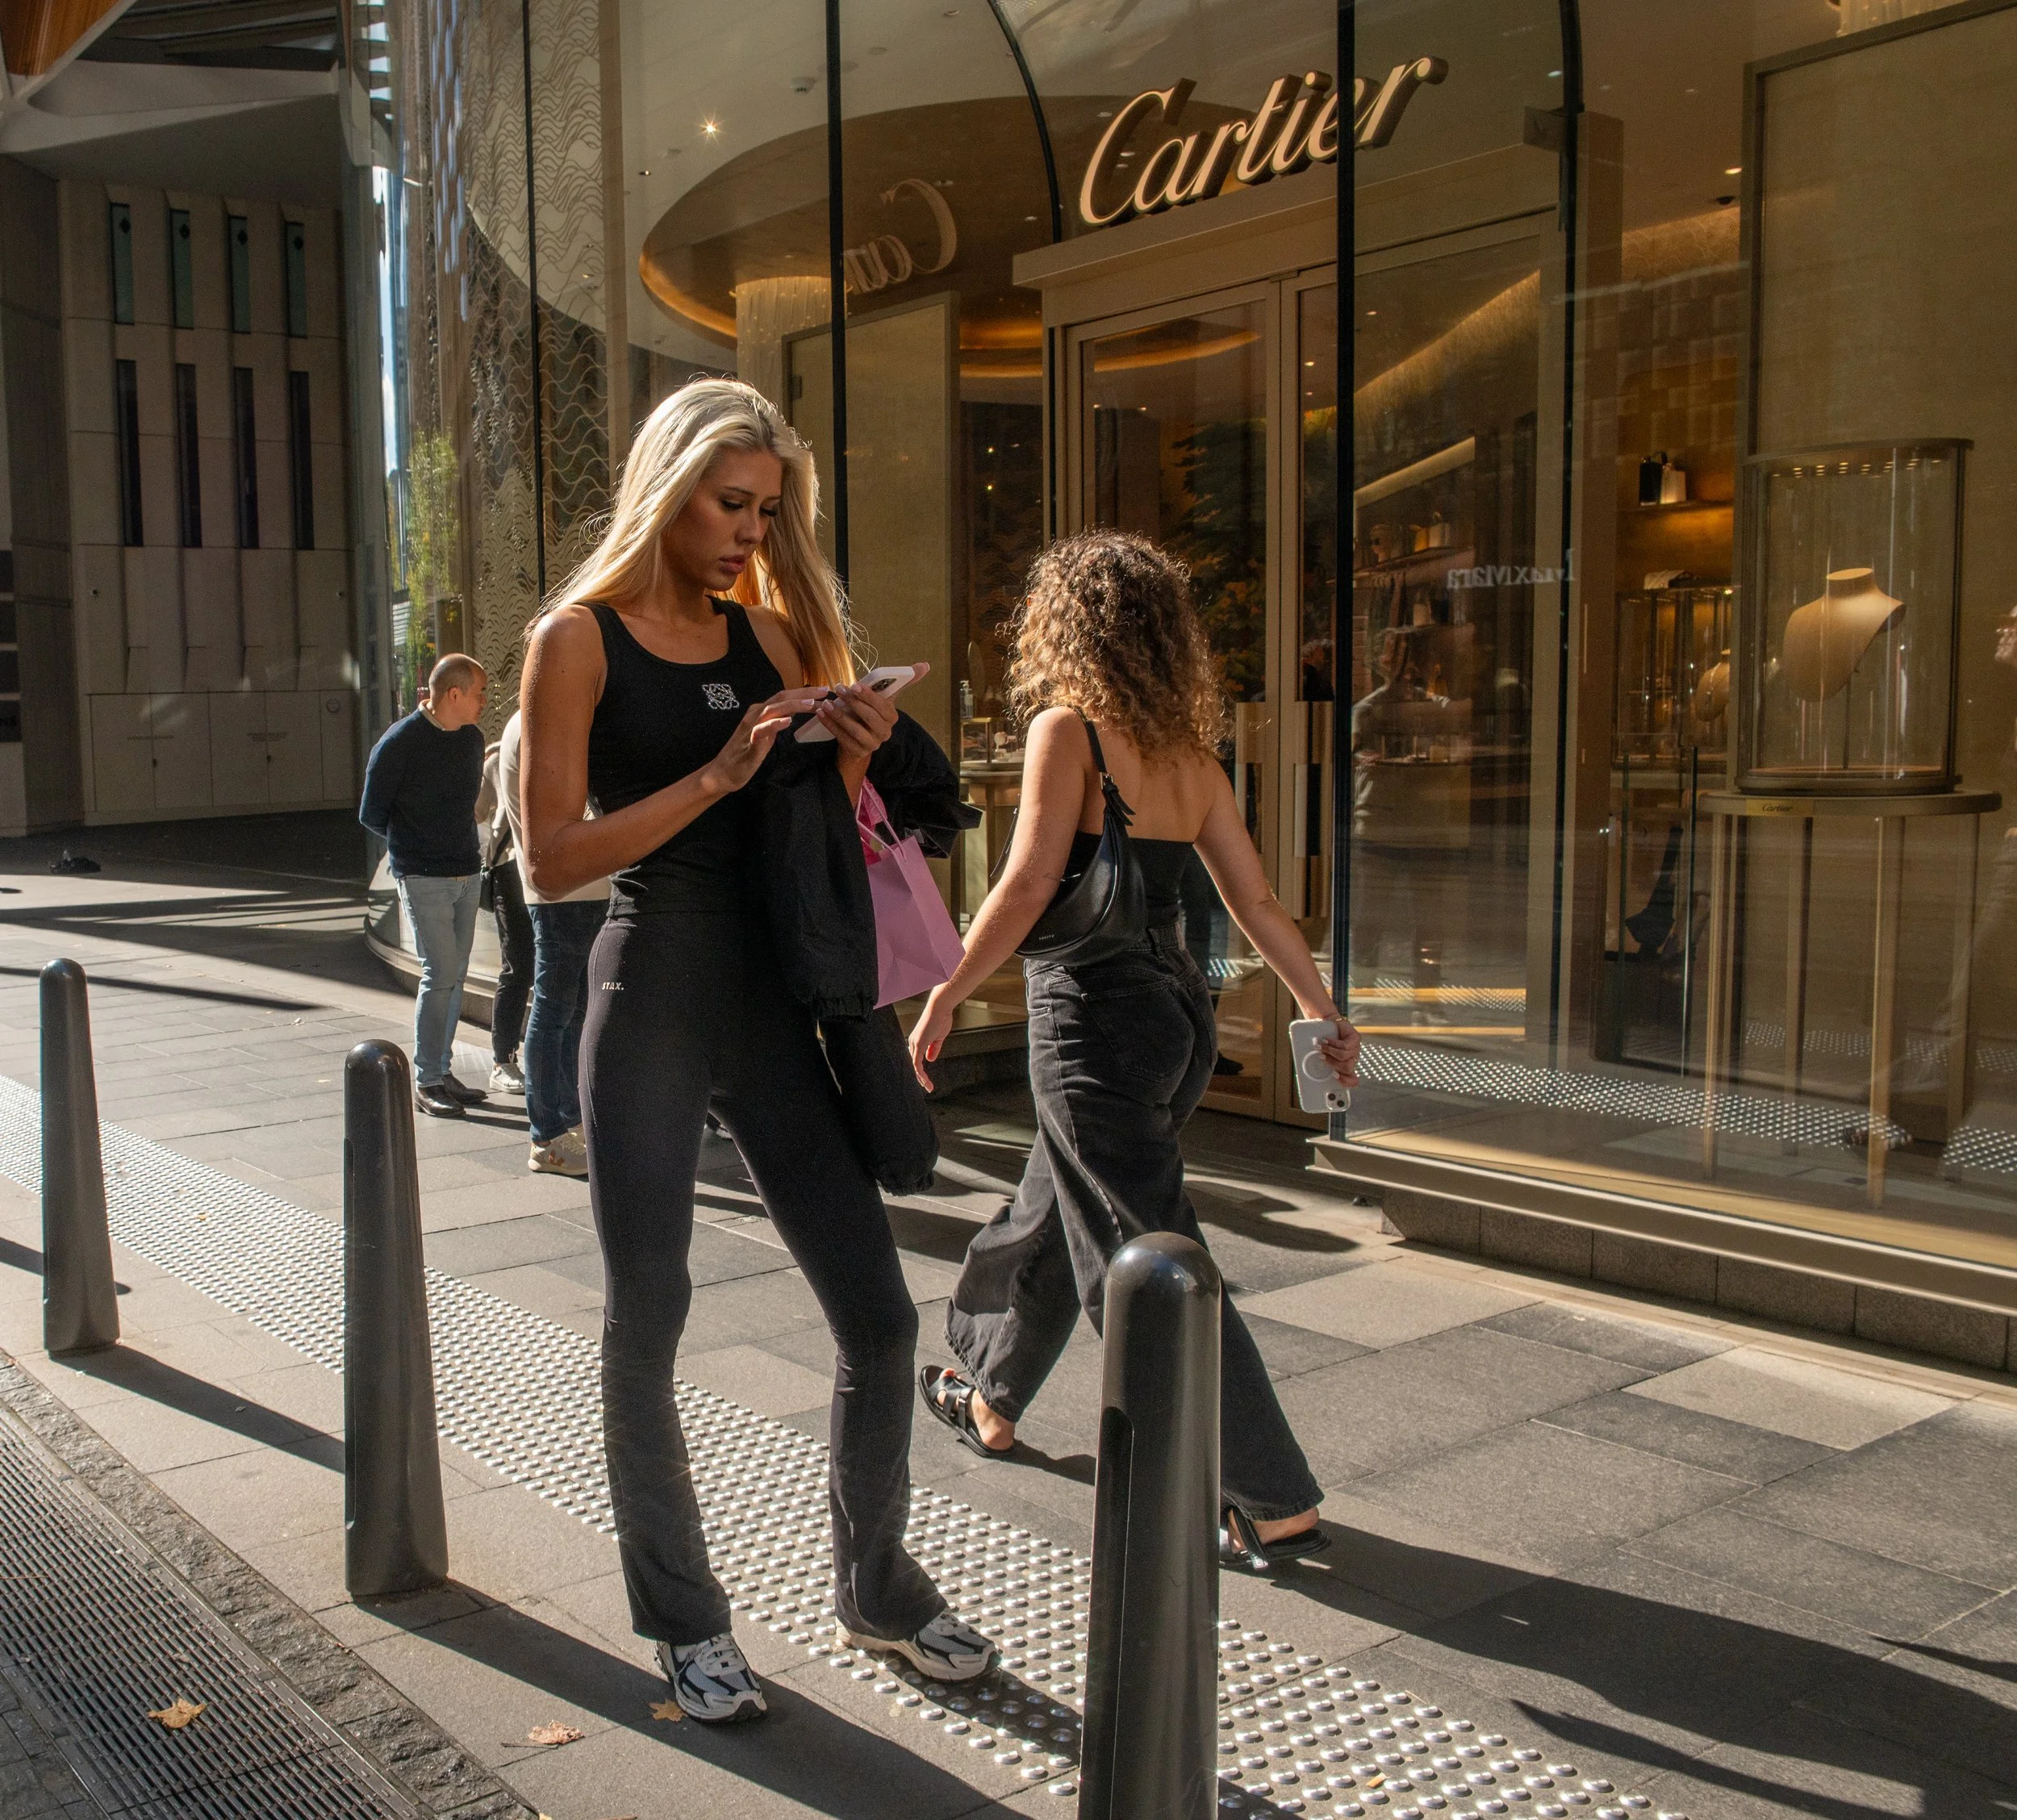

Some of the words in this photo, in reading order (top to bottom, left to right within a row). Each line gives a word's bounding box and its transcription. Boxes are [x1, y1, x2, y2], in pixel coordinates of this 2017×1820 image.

[1079, 56, 1449, 227] Cartier
[1762, 803, 1793, 812] Cartier
[602, 982, 624, 991] STAX.
